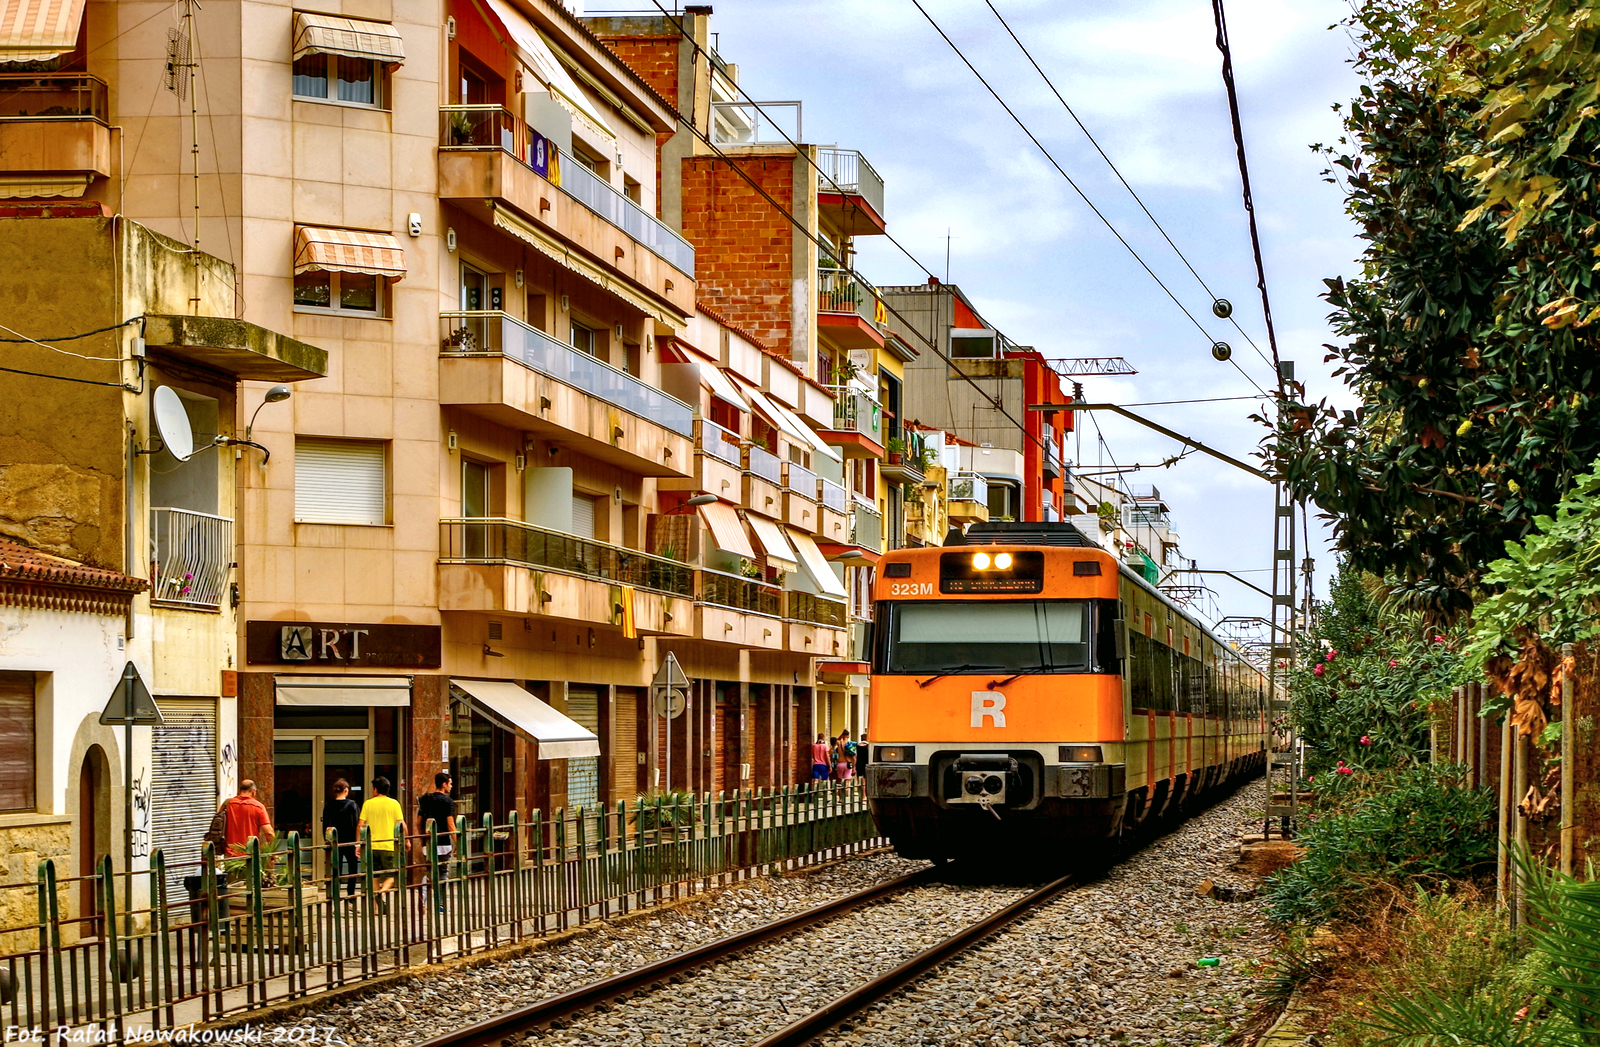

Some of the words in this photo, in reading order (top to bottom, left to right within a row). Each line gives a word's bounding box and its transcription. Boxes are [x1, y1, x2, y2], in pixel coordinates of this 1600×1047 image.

[891, 583, 933, 595] 323M
[283, 627, 369, 660] ART
[970, 691, 1006, 727] R
